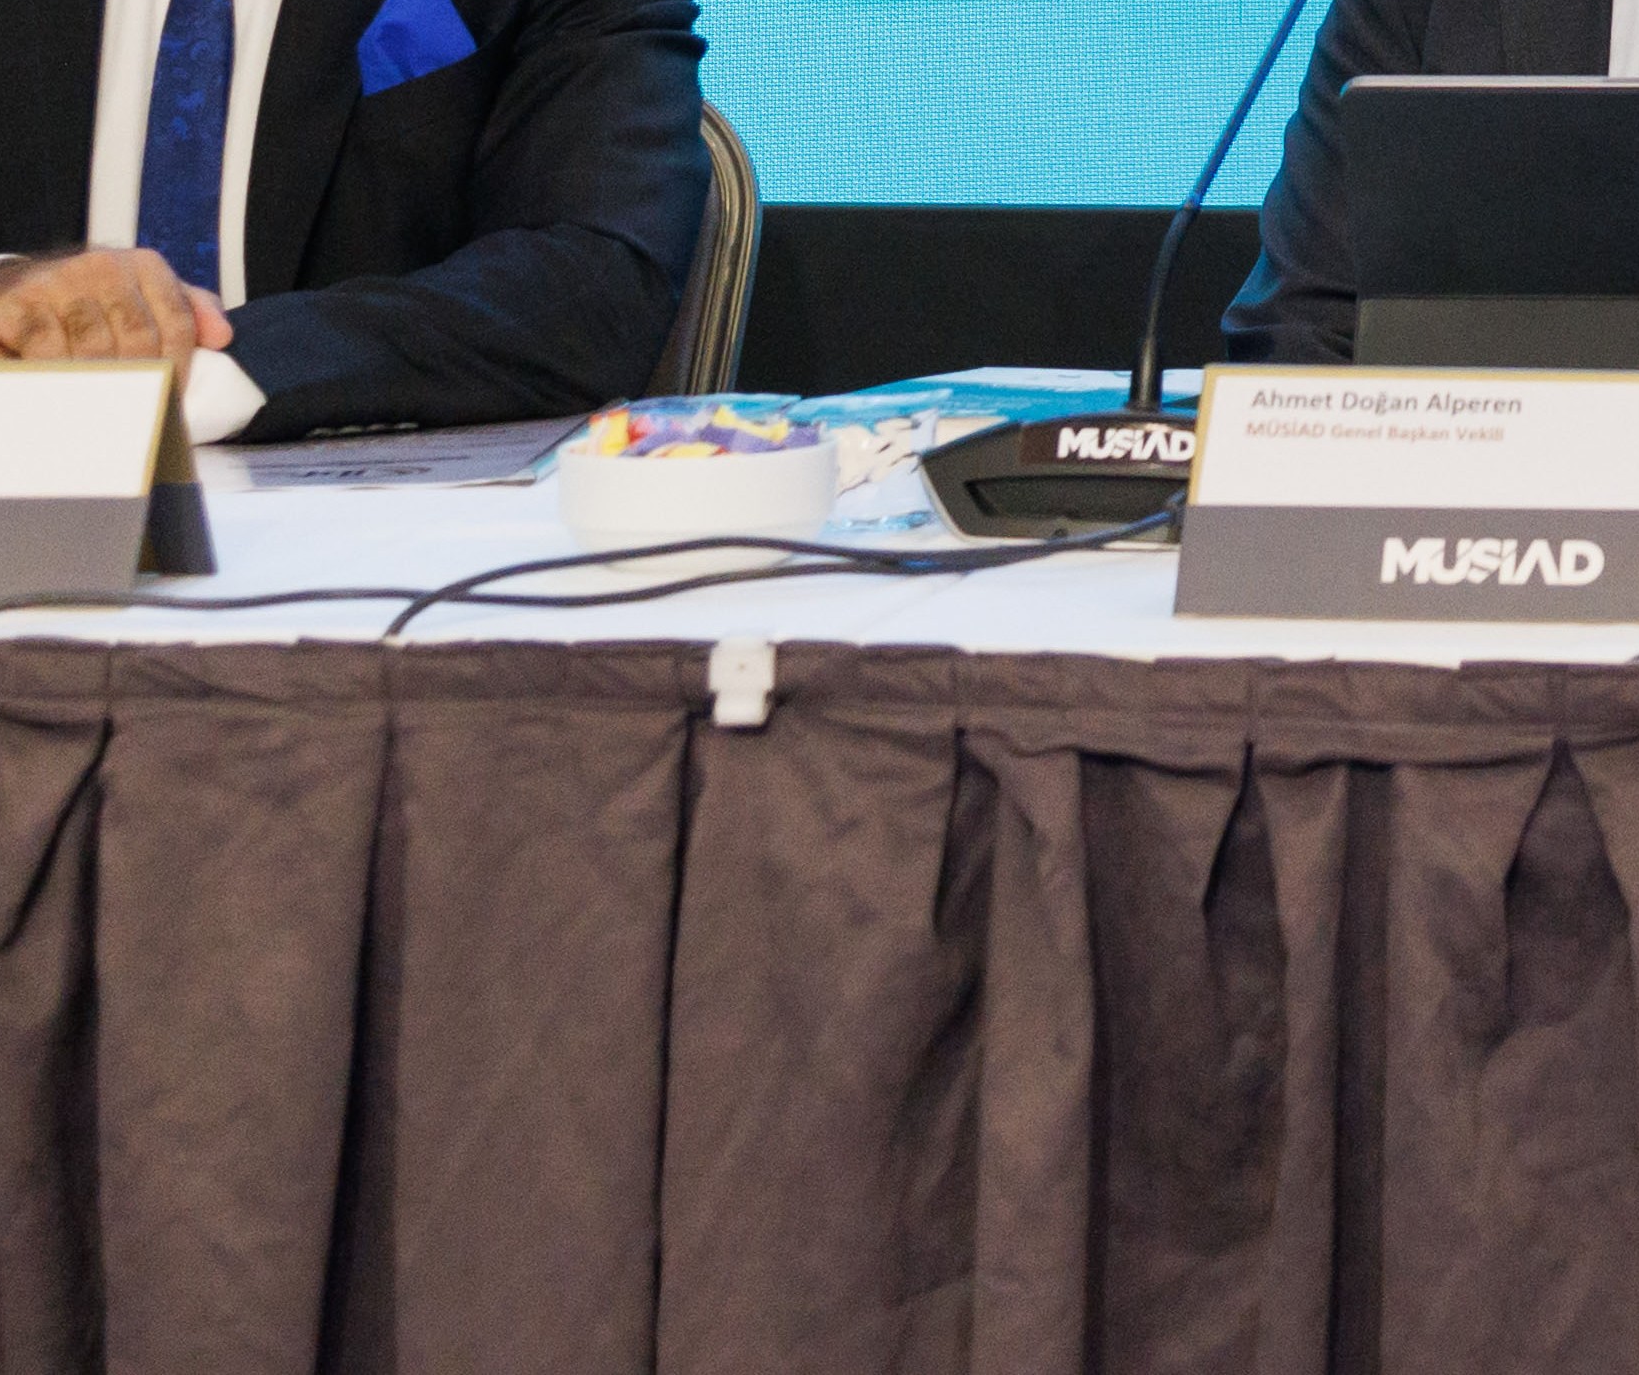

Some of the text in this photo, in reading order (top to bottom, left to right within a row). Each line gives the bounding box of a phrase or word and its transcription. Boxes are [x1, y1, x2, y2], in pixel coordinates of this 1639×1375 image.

[1251, 389, 1522, 416] Ahmet Doğan Alperen
[1330, 424, 1382, 440] Genel
[1387, 425, 1451, 444] Başkan
